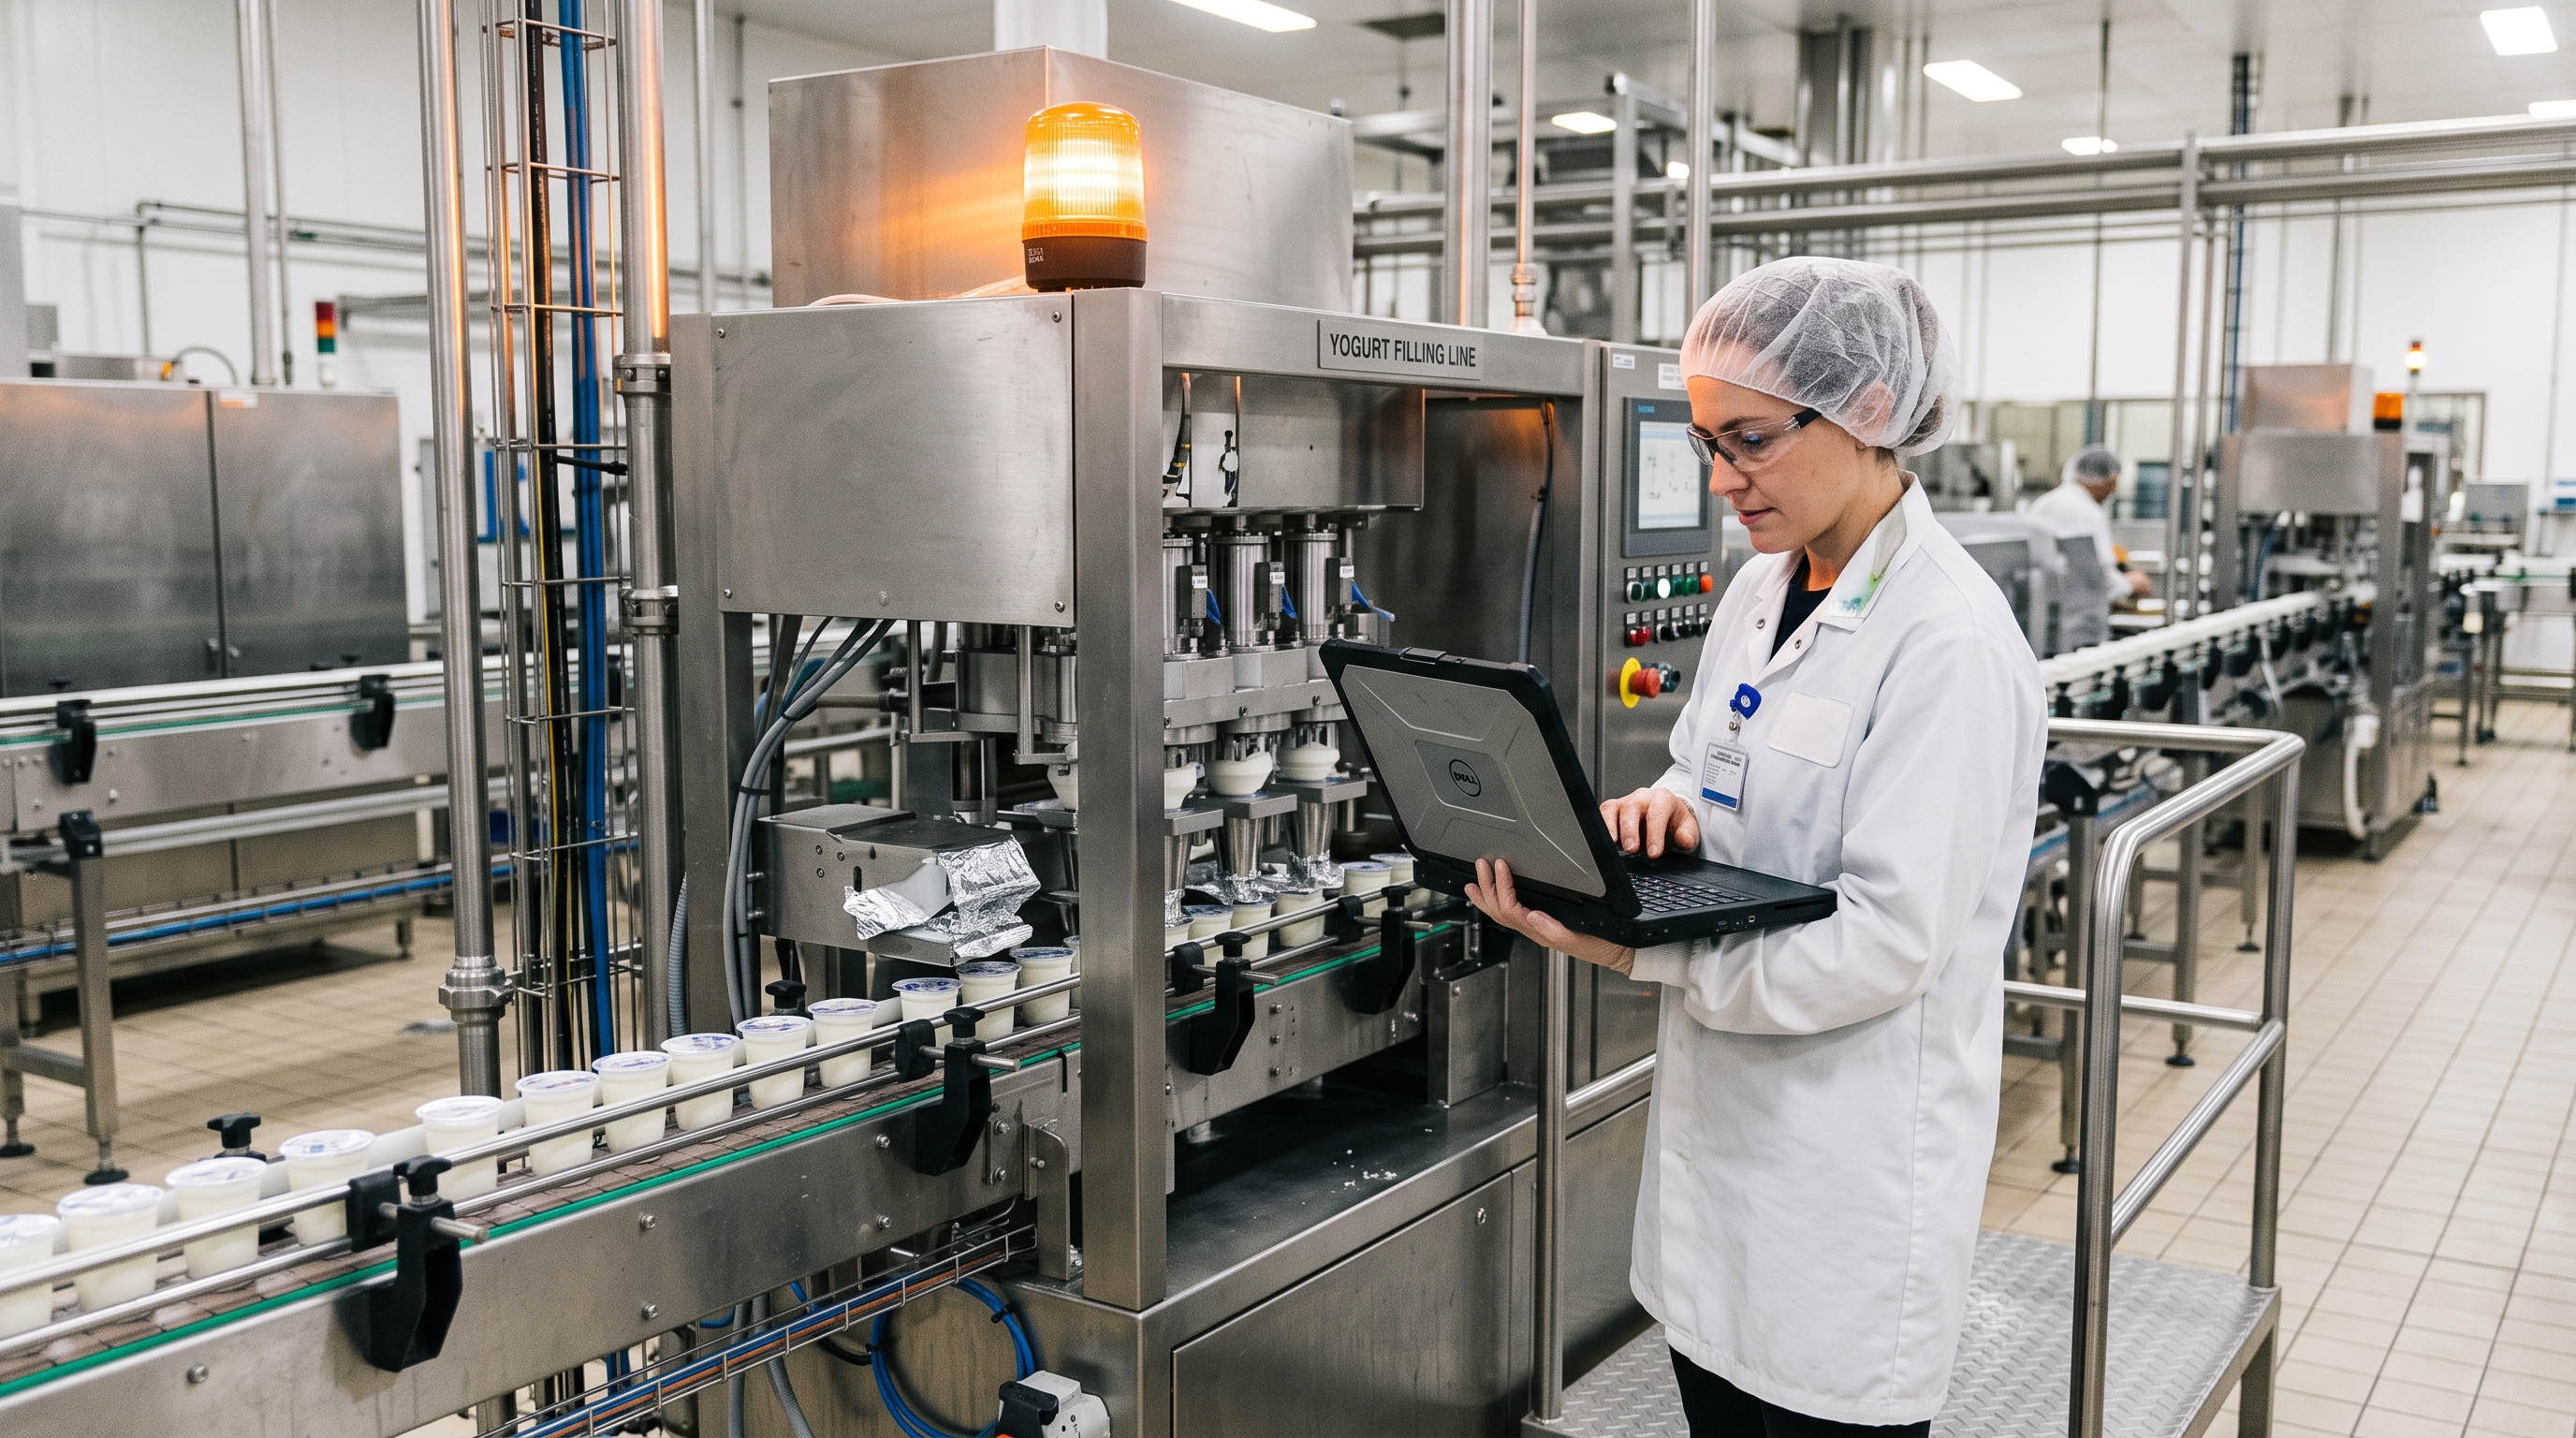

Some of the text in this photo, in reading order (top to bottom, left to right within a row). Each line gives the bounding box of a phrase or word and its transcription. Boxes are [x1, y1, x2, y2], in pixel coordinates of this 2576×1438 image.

[1330, 333, 1476, 368] YOGURT FILLING LINE
